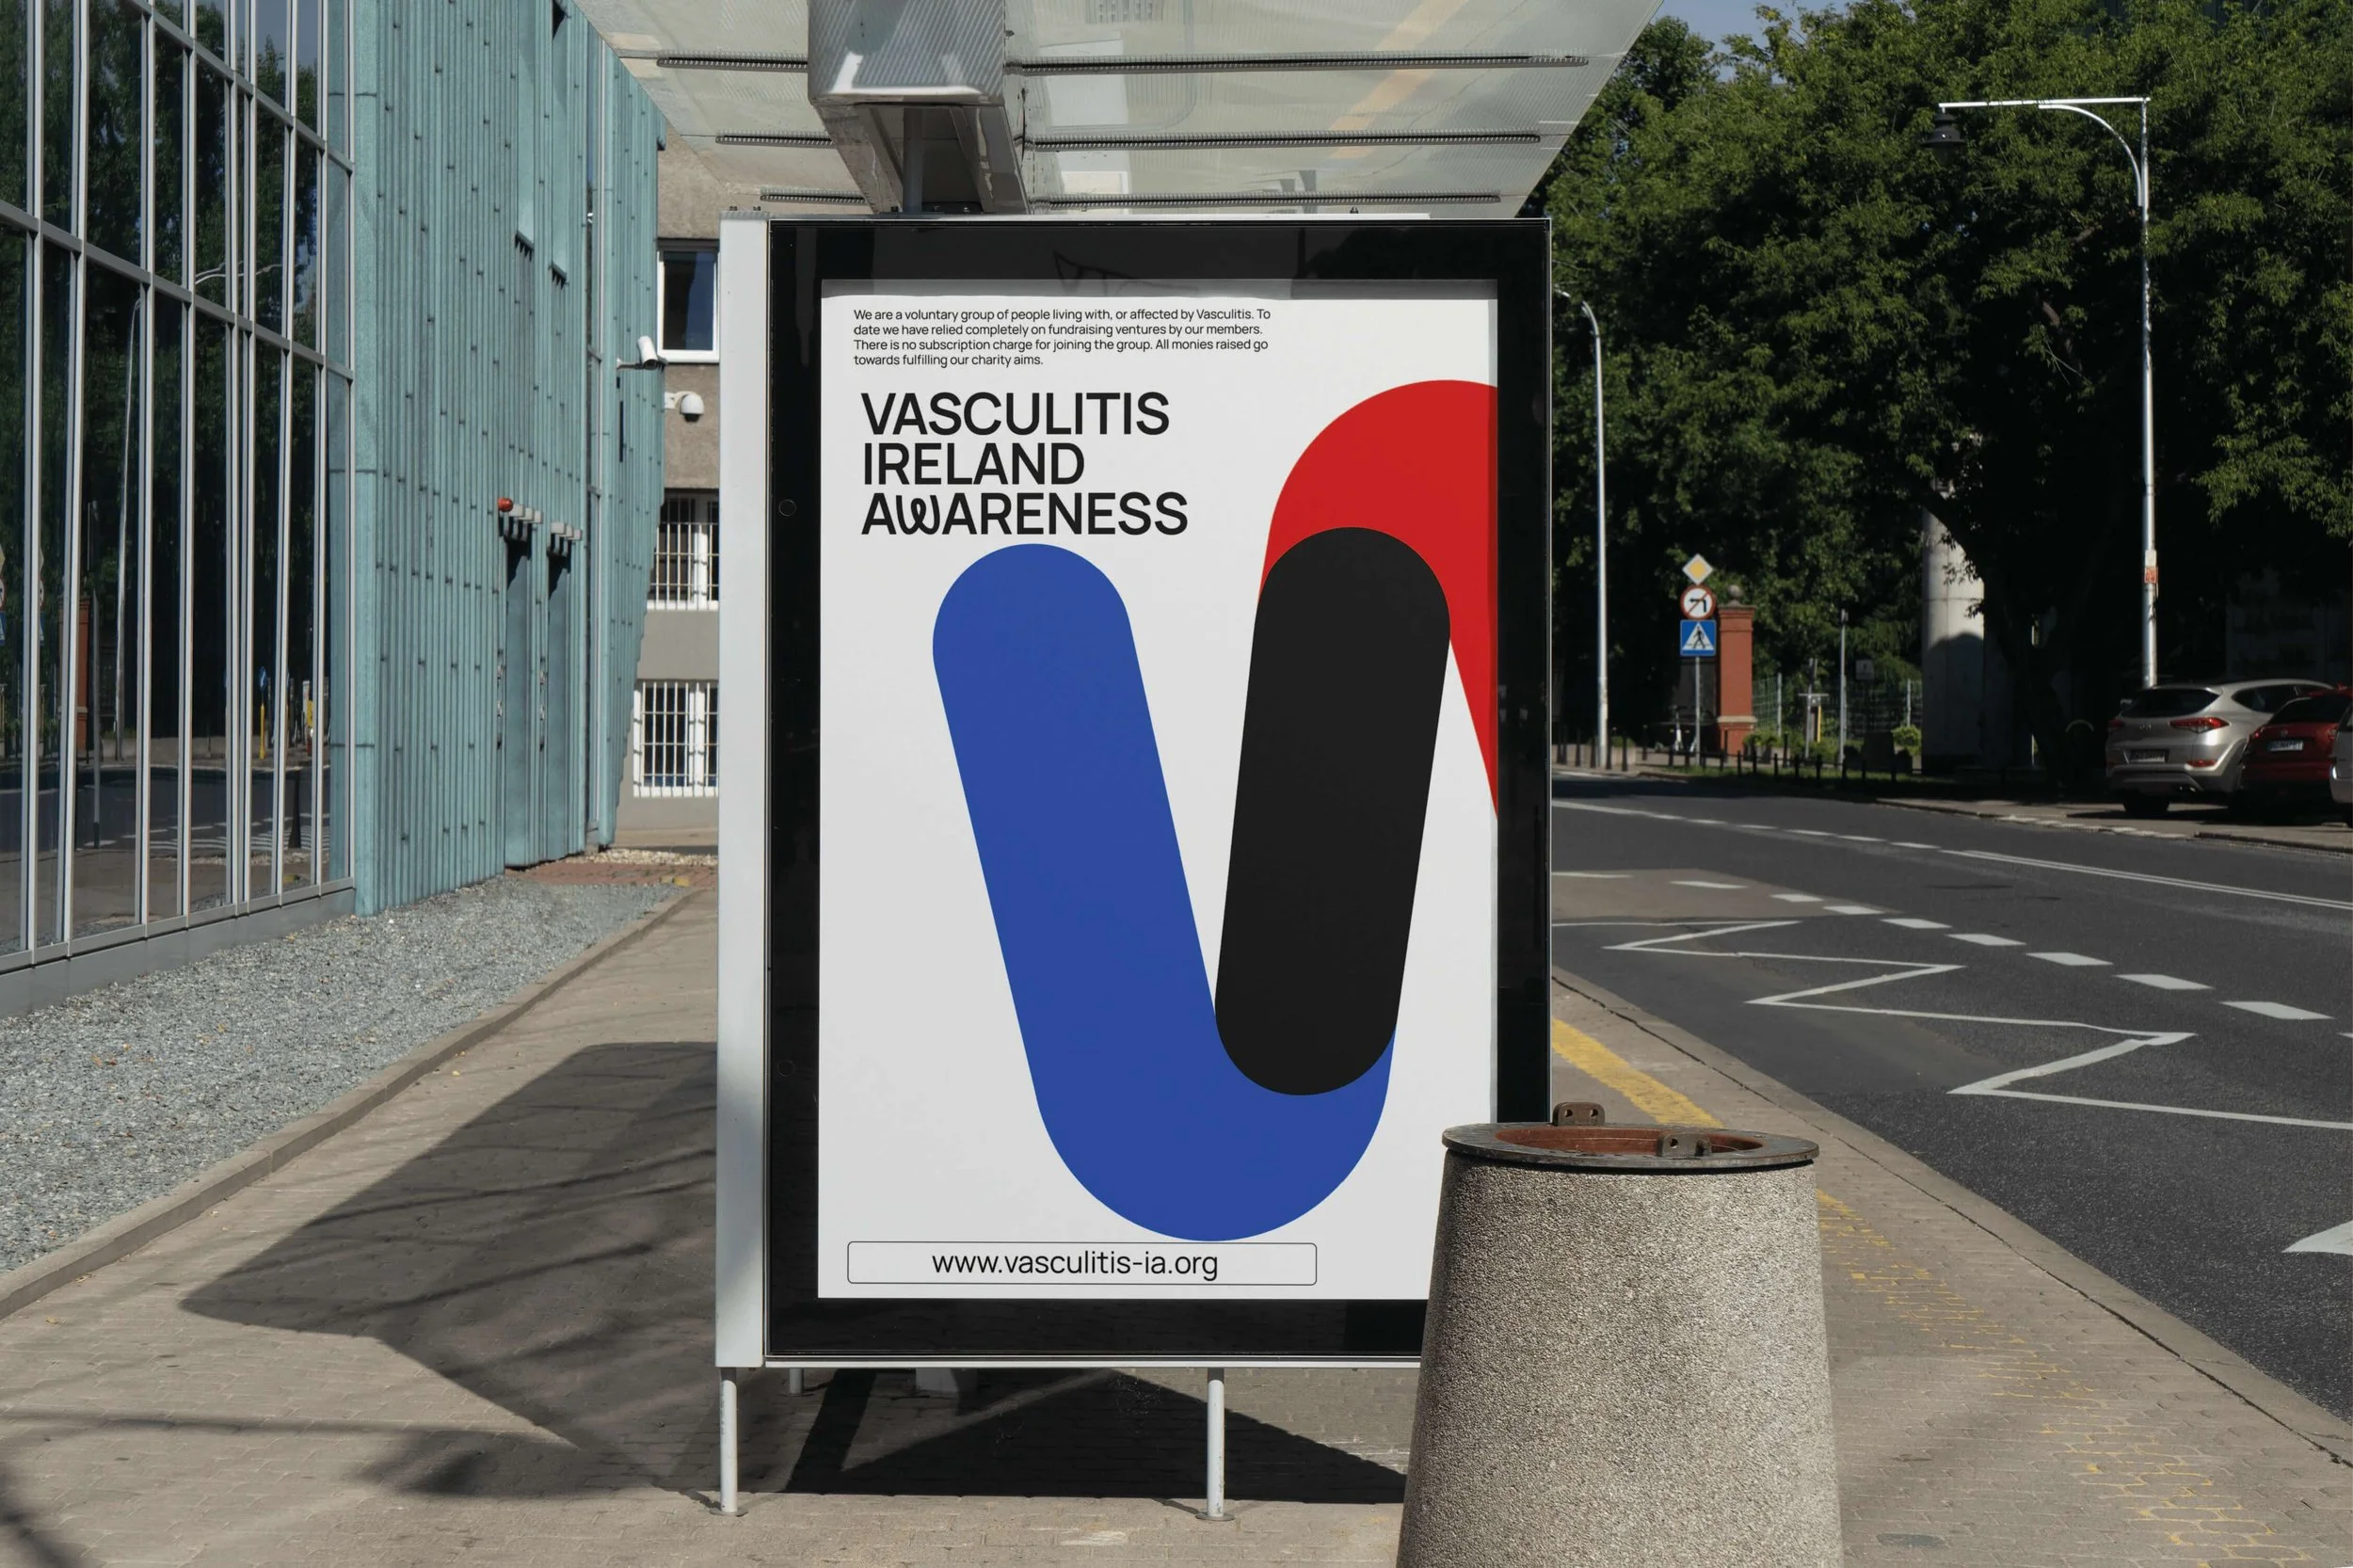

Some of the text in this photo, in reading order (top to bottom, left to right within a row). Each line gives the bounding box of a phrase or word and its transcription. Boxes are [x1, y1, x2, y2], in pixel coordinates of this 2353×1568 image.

[854, 308, 1271, 324] We are a voluntary group of people living with, or affected by Vasculitis. To
[854, 323, 1262, 339] date we have relied completely on fundraising ventures by our members.
[854, 338, 1268, 354] There is no subscription charge for joining the group. All monies raised go
[854, 354, 1043, 369] towards fulfilling our charity aims.
[861, 392, 1169, 435] VASCULITIS
[865, 442, 1084, 485] IRELAND
[861, 492, 1188, 535] AWARENESS
[932, 1251, 1217, 1281] www.vasculitis-ia.org
